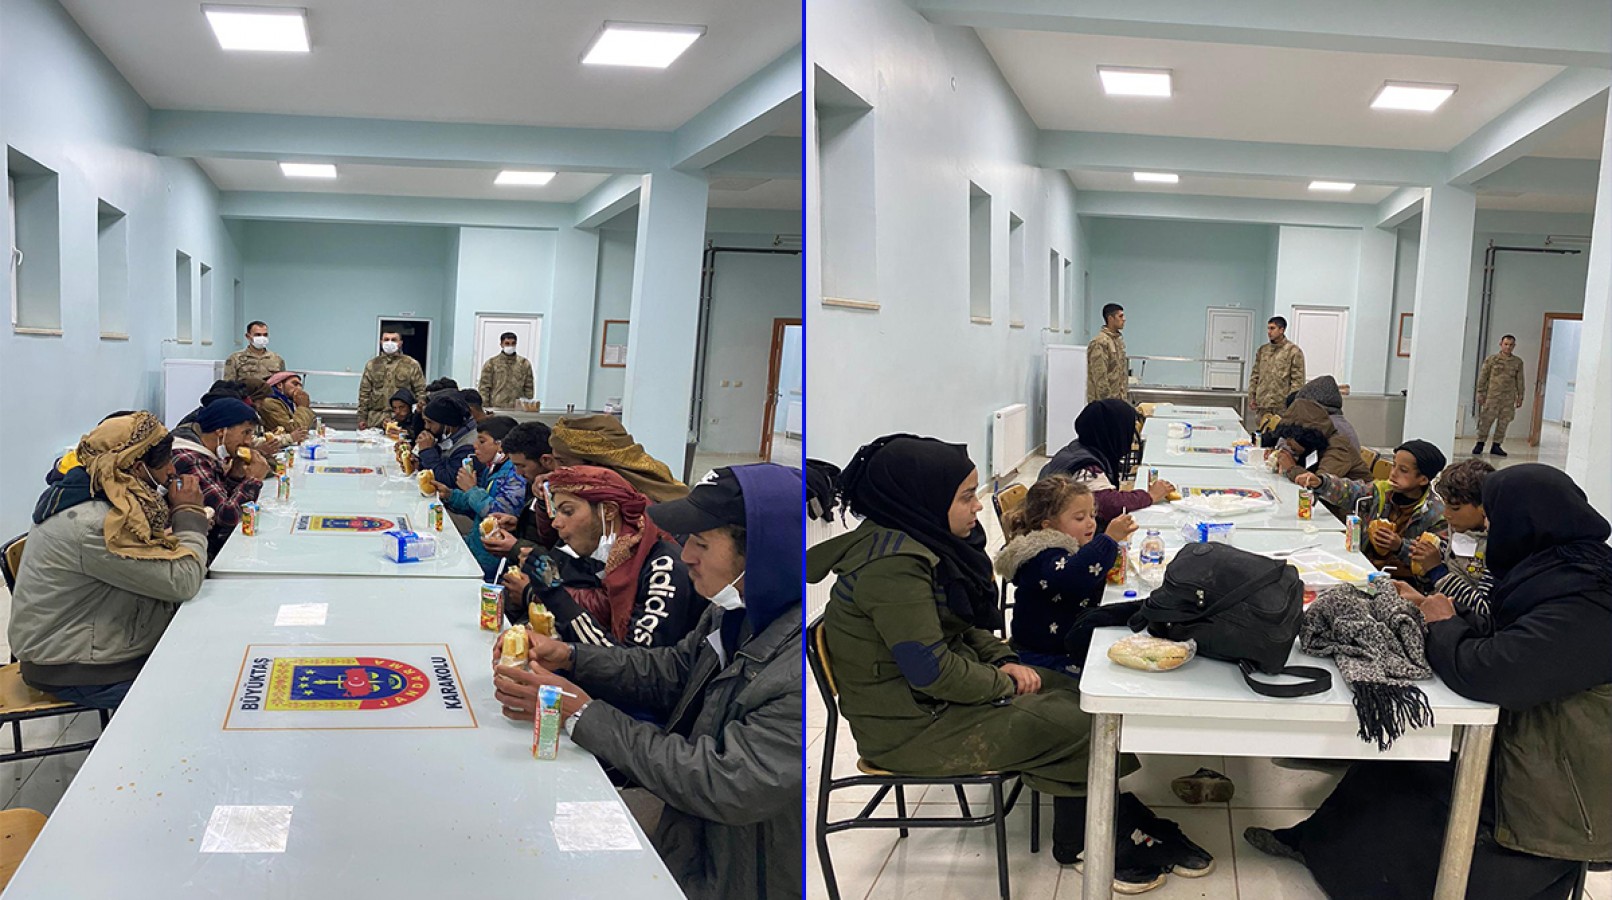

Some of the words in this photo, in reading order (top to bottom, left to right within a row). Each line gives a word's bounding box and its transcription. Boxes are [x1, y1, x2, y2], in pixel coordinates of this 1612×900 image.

[633, 555, 677, 647] adidas
[241, 656, 273, 711] BÜYÜKTAŞ
[374, 659, 424, 708] JANDARMA
[431, 656, 463, 709] KARAKOLU
